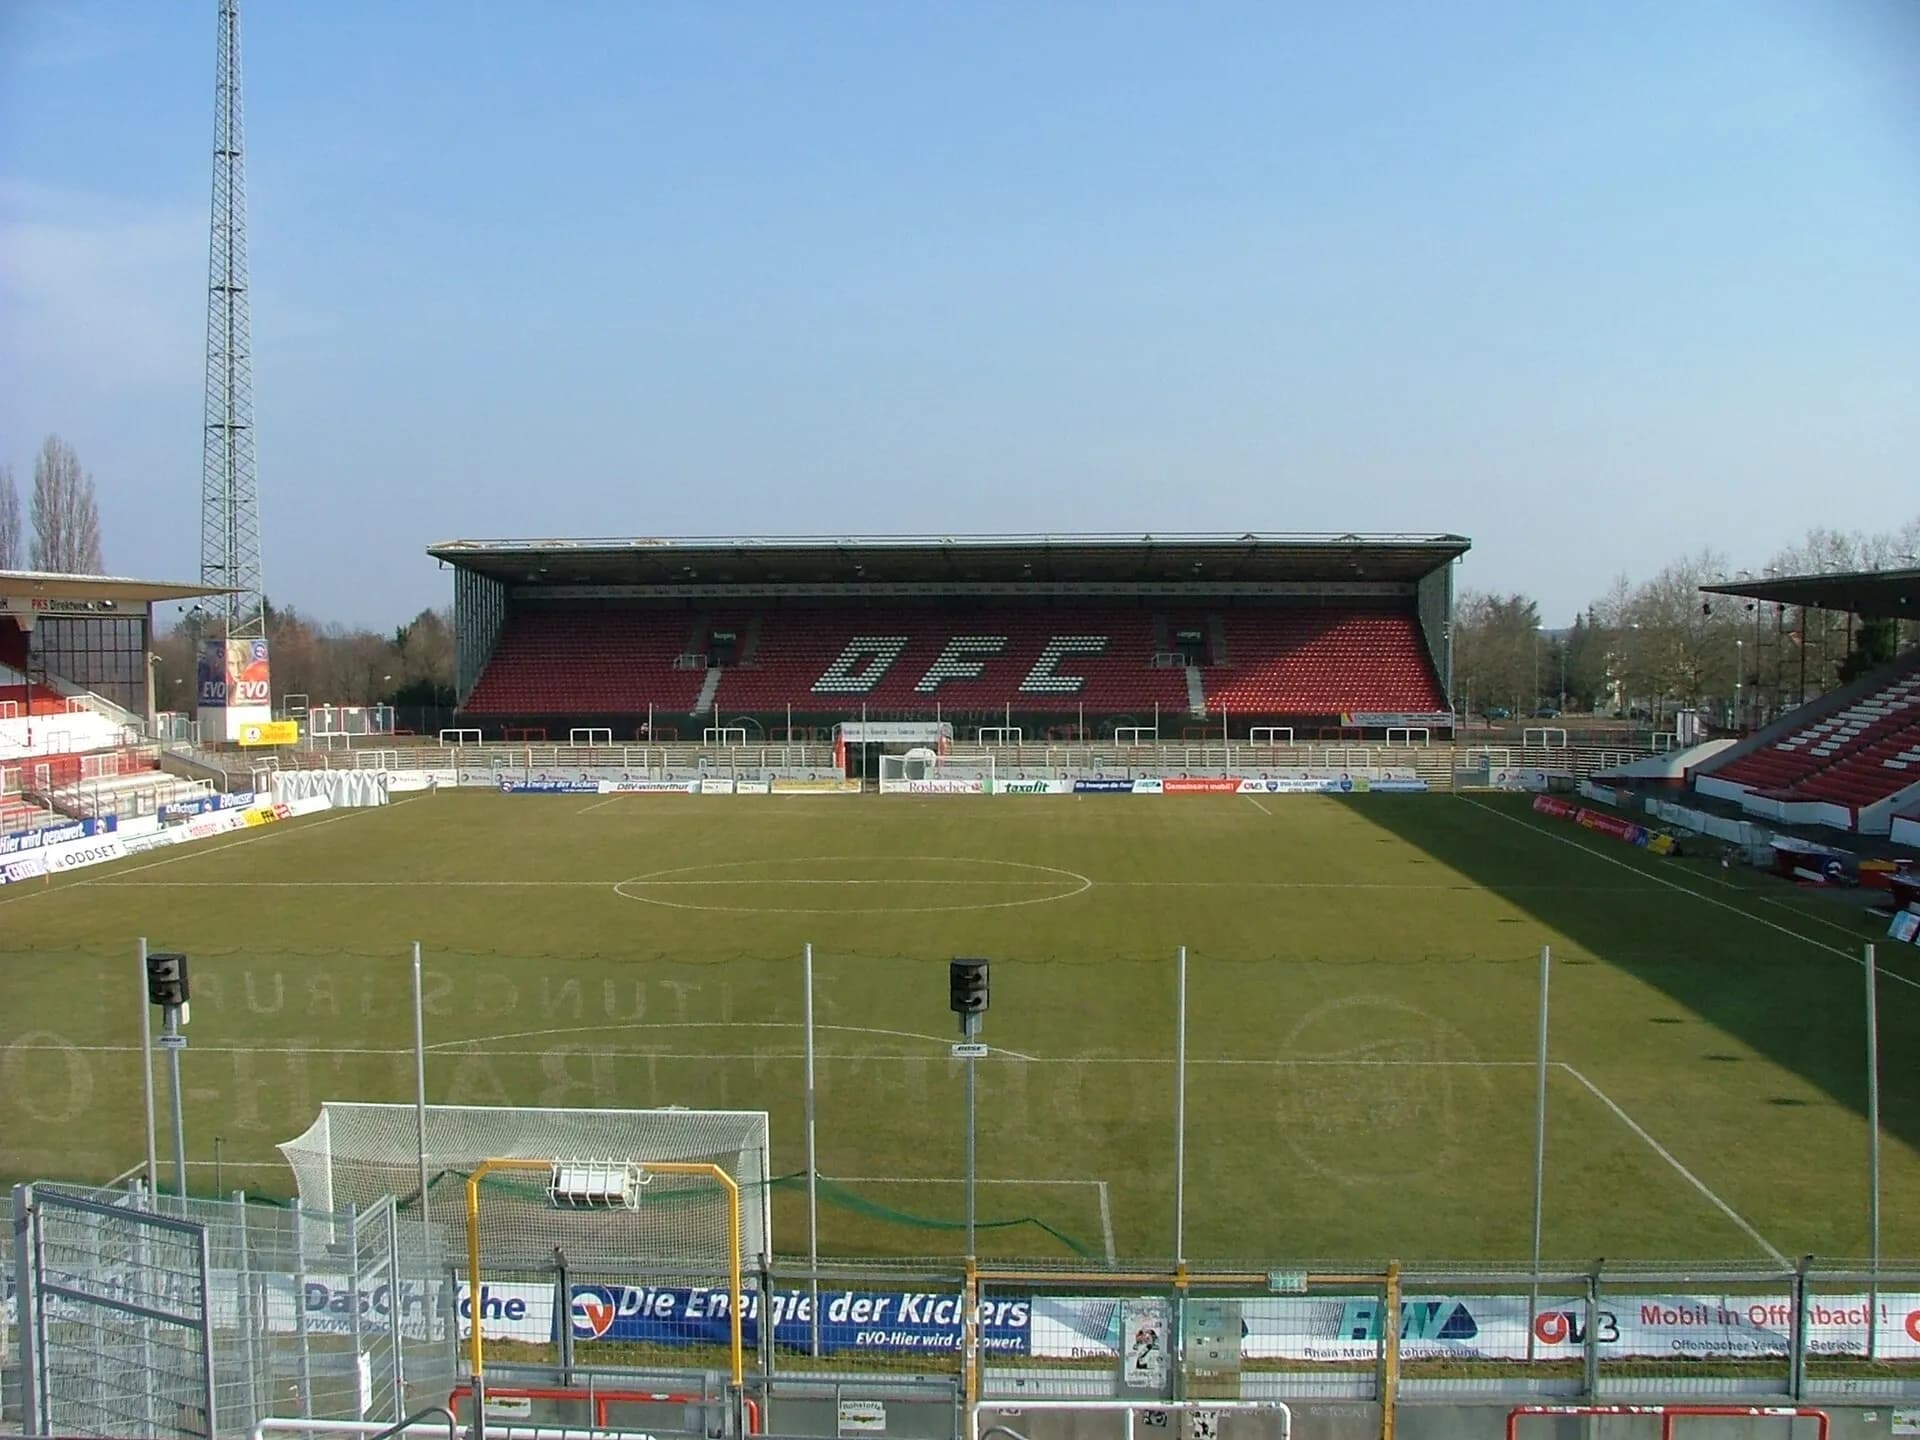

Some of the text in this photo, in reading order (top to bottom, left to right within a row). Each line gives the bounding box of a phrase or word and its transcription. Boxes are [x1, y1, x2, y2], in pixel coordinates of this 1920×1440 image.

[810, 635, 1110, 693] OFC
[203, 681, 225, 698] EVO
[236, 681, 268, 698] EVO
[1006, 780, 1050, 793] taxofit
[65, 844, 117, 867] ODDSET
[618, 1287, 675, 1317] Die
[828, 1292, 890, 1323] der
[1641, 1305, 1708, 1325] Mobil
[1718, 1305, 1740, 1325] in
[856, 1331, 1025, 1350] EVO-Hier wird gowert.
[1672, 1340, 1748, 1351] Offenbacher
[1304, 1347, 1338, 1358] Rhein
[1342, 1347, 1373, 1358] Main
